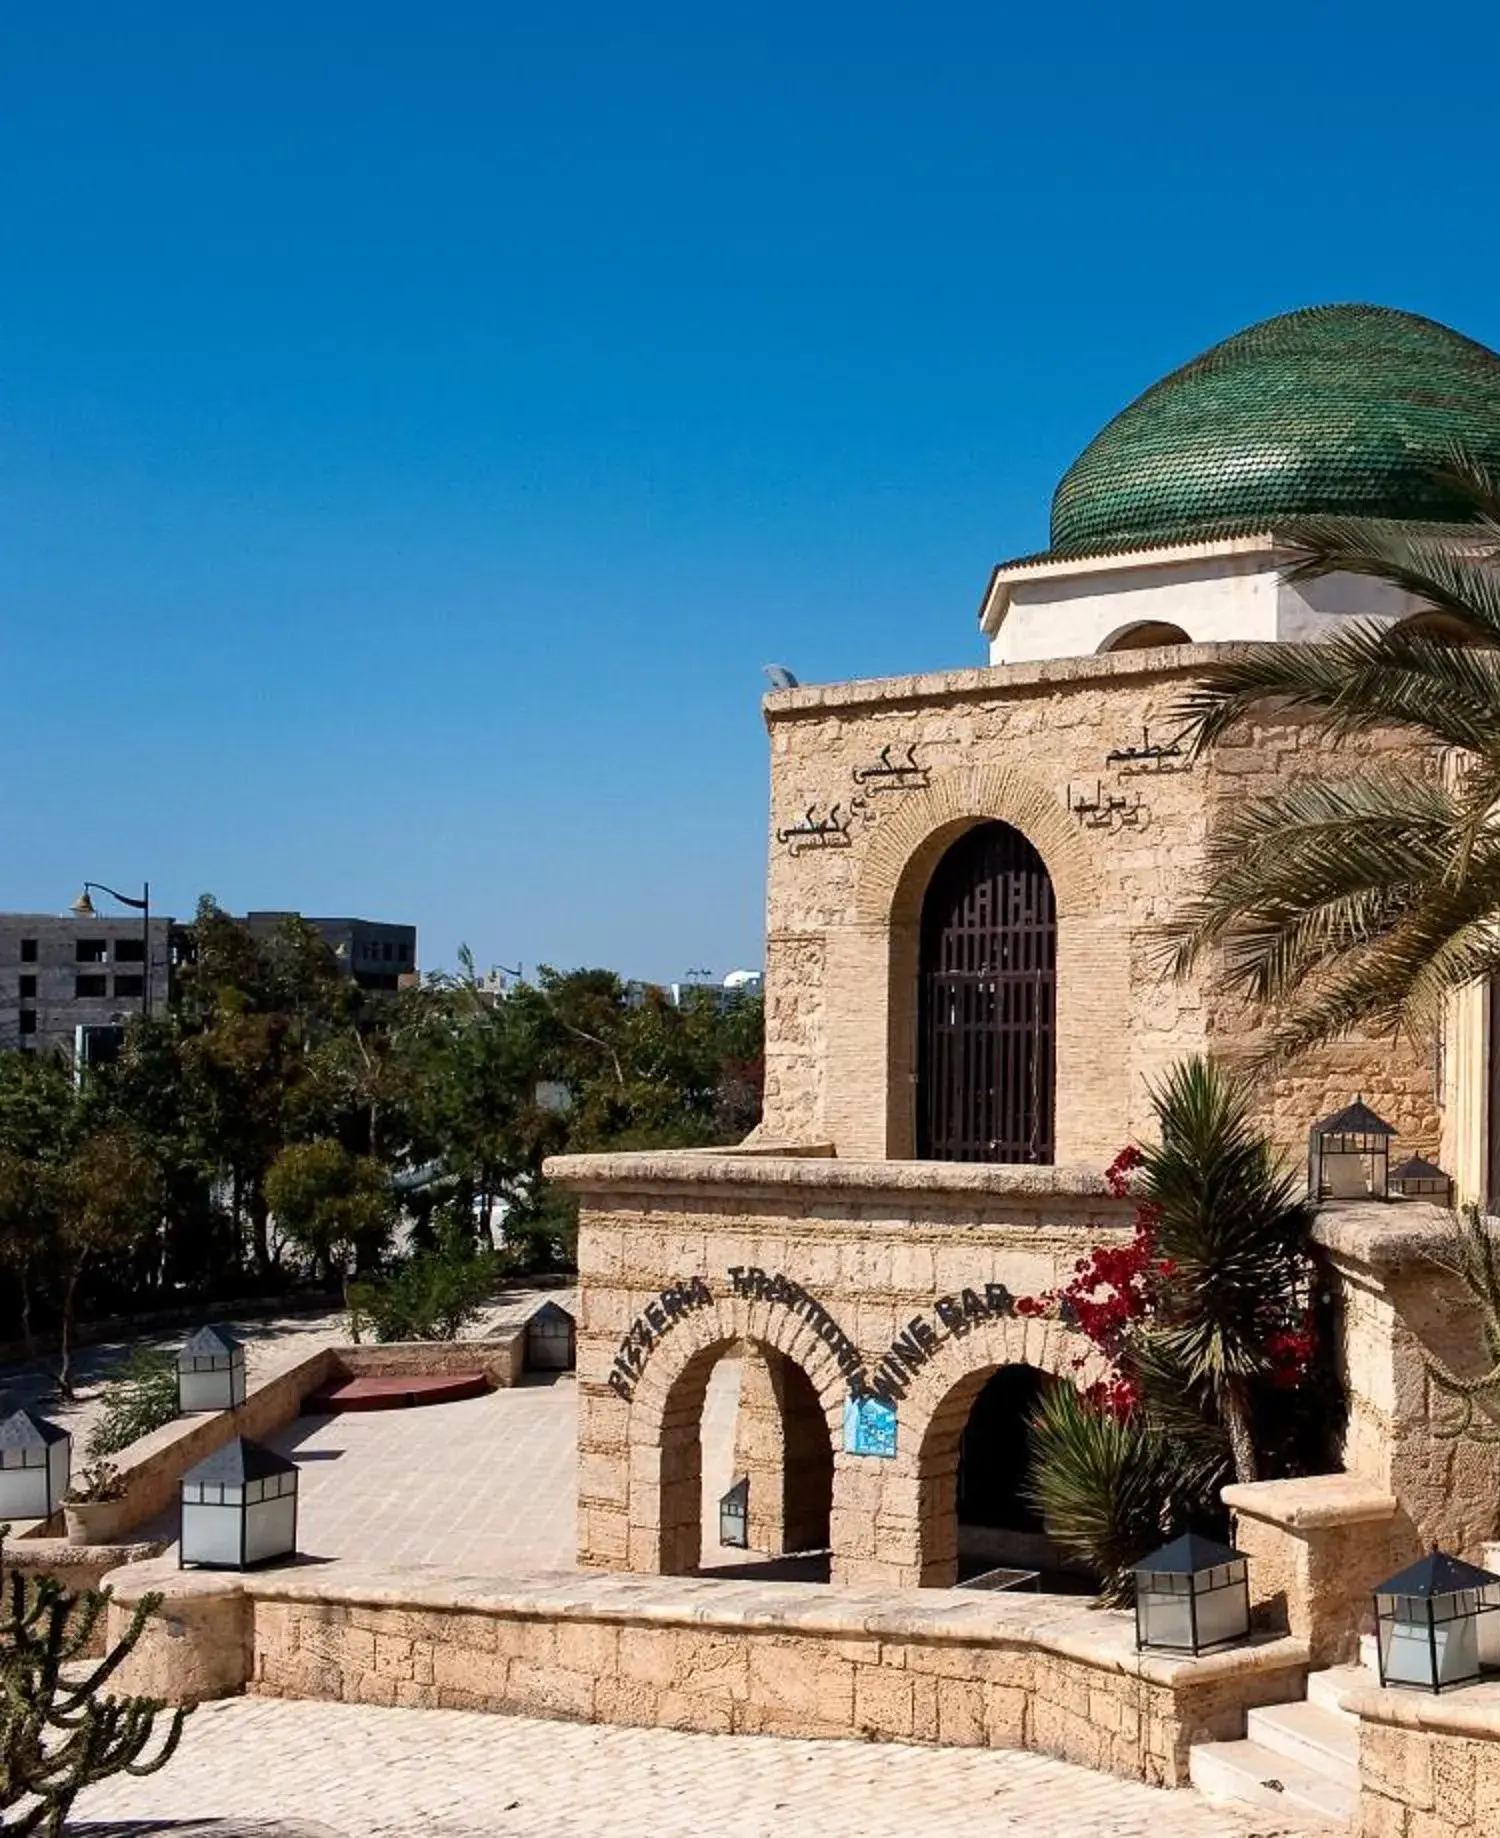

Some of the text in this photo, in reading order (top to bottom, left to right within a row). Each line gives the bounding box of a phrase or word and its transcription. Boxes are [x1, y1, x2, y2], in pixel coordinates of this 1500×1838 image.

[608, 1266, 868, 1404] PIZZERIA TRATTORIA
[871, 1314, 937, 1402] WINE
[933, 1284, 1015, 1339] BAR
